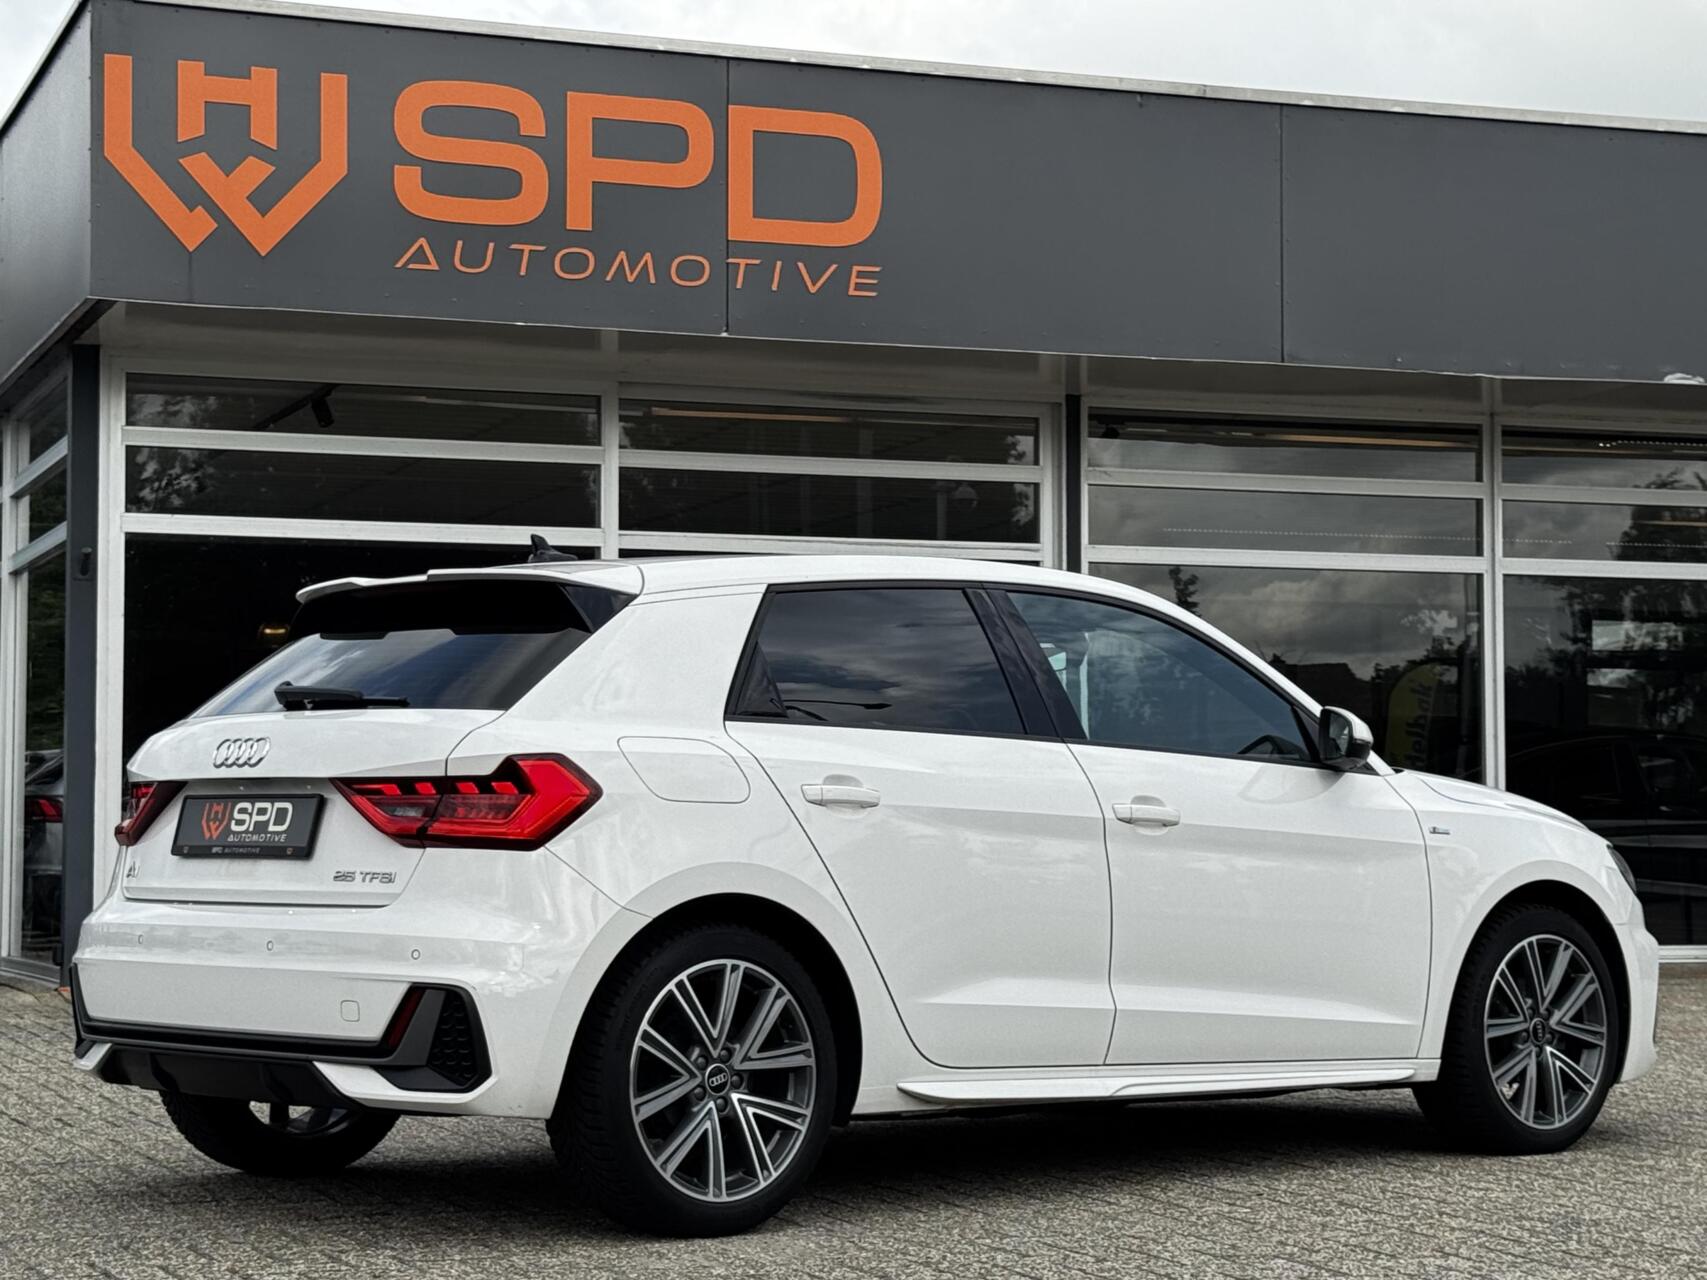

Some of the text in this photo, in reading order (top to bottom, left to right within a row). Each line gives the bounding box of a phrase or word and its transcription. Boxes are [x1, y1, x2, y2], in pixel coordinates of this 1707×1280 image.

[393, 80, 883, 248] SPD
[396, 238, 881, 298] AUTOMOTIVE
[230, 801, 293, 832] SPD
[227, 833, 288, 843] AUTOMOTIVE
[333, 870, 356, 883] 25
